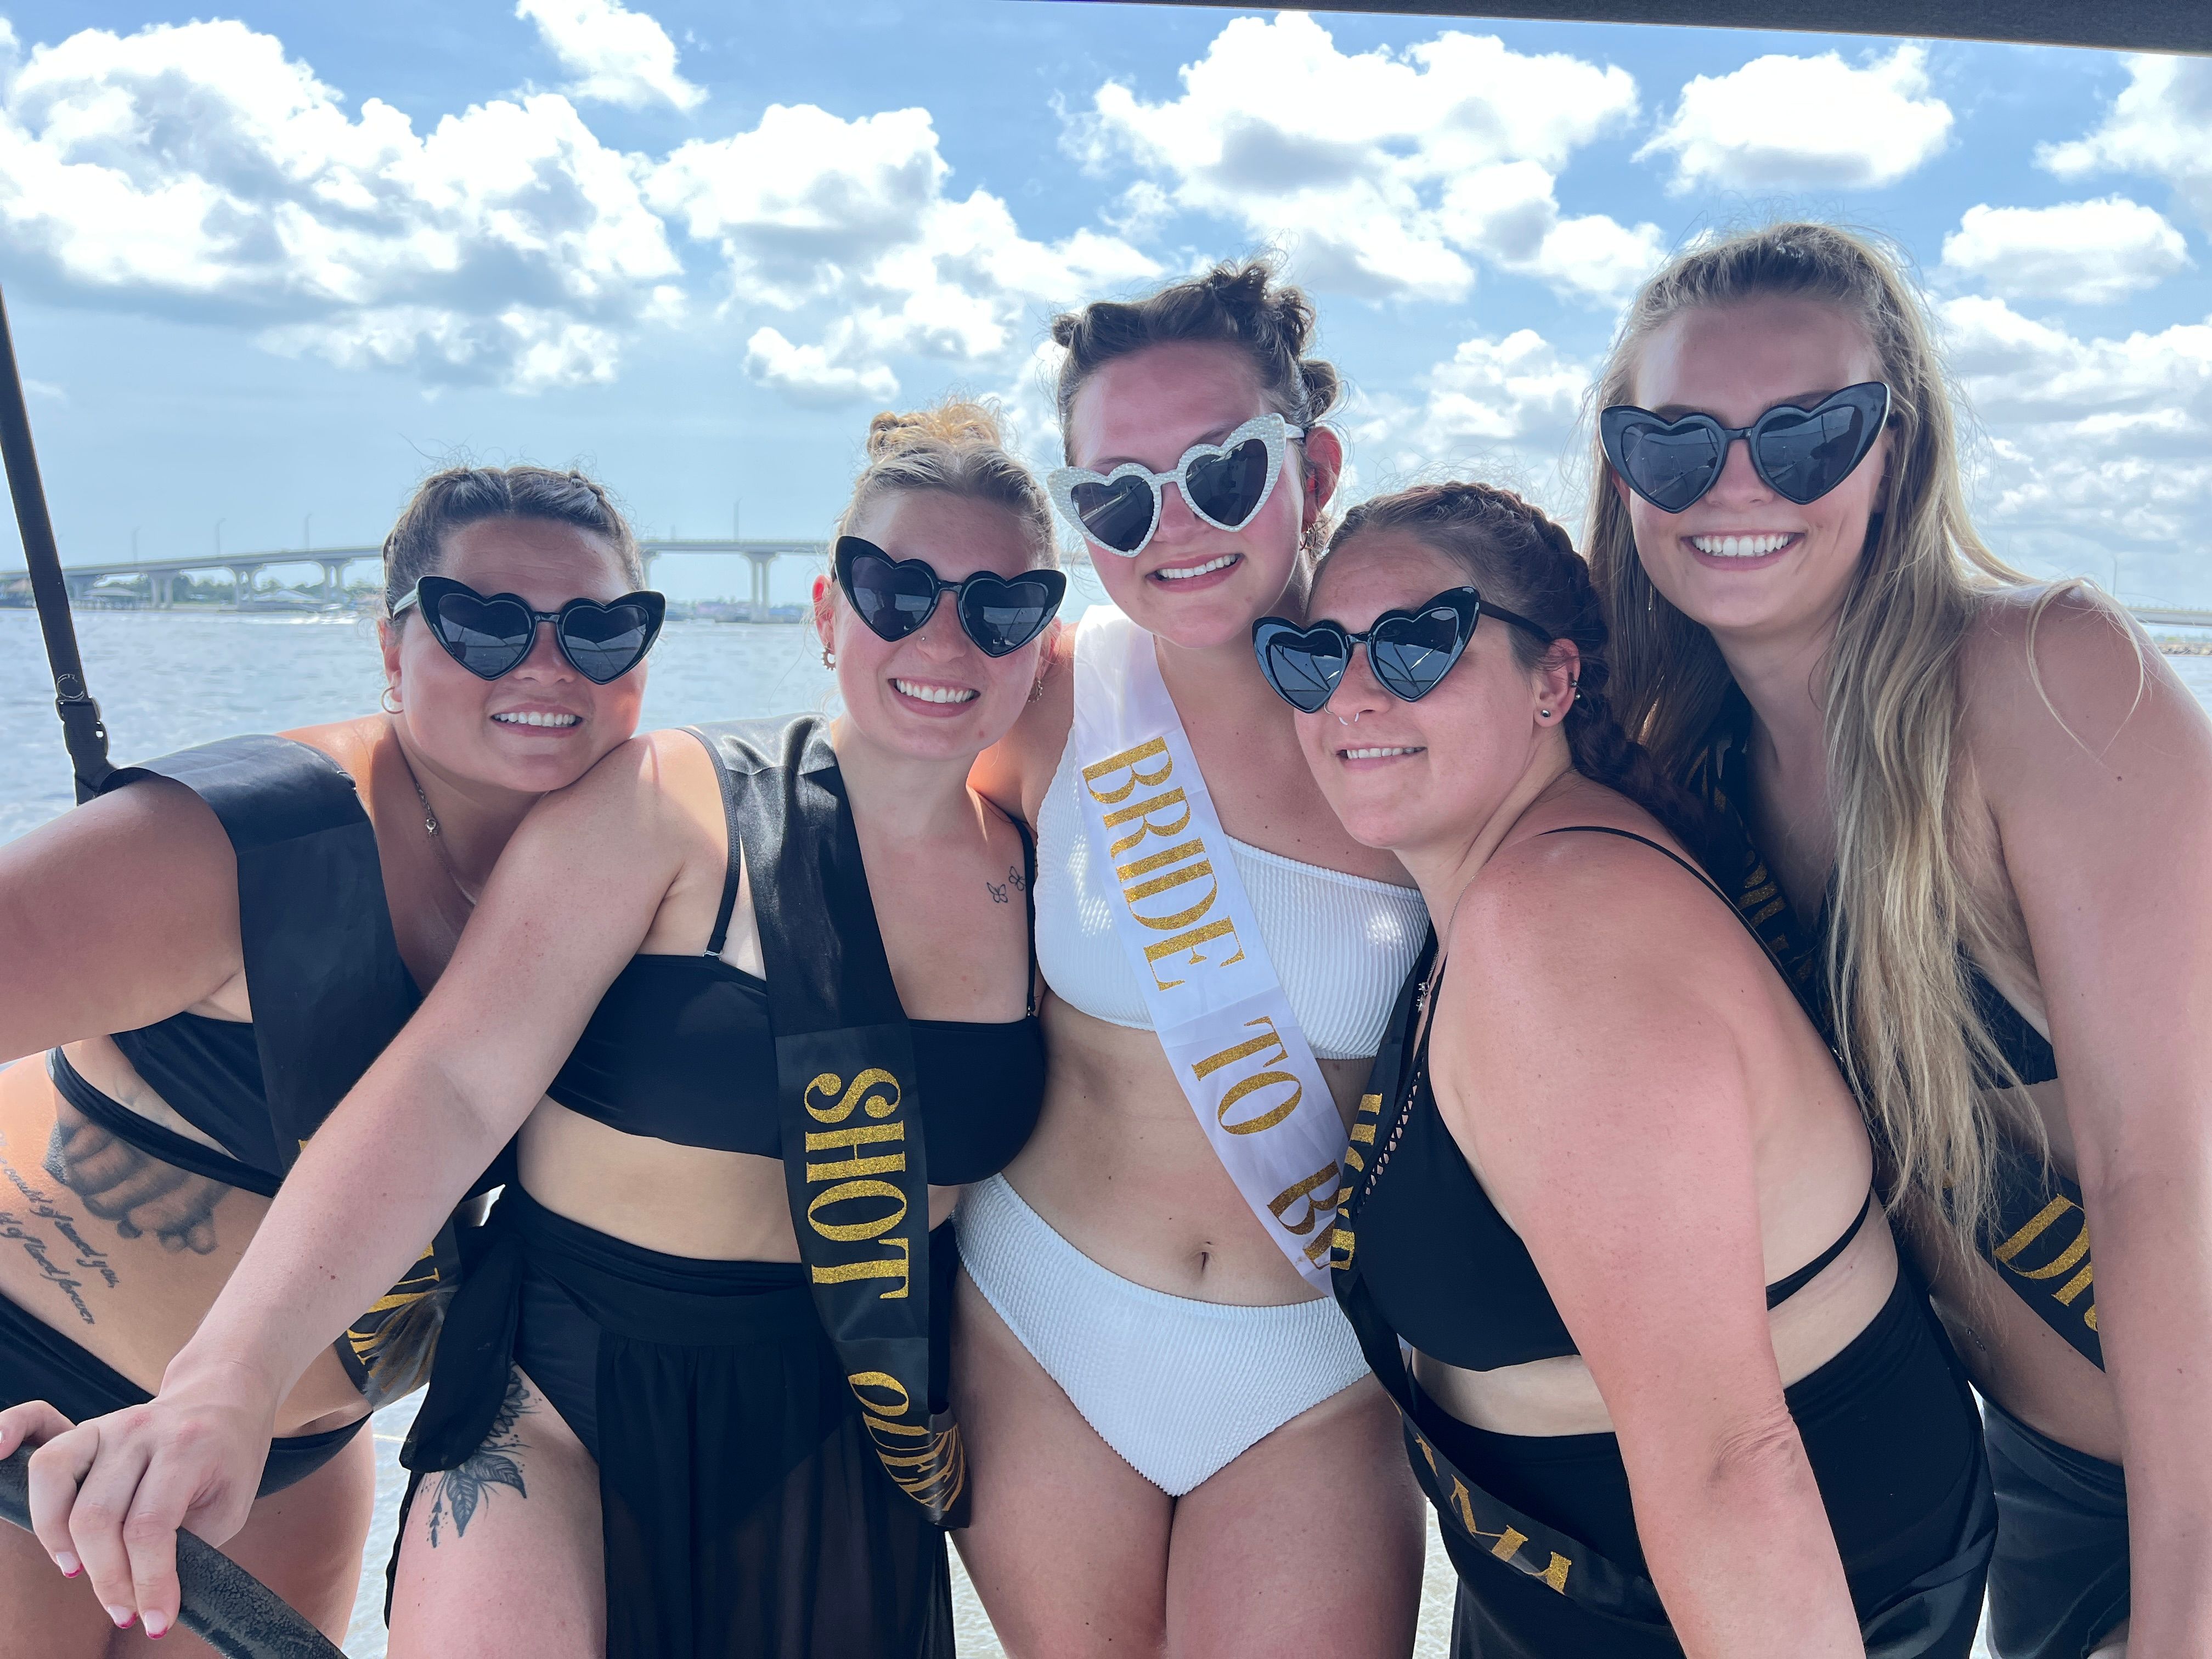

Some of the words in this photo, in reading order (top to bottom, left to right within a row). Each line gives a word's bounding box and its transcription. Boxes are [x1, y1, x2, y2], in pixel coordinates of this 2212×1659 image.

[1082, 736, 1245, 992] BRIDE
[1192, 1016, 1302, 1135] TO
[804, 1068, 910, 1299] SHOT
